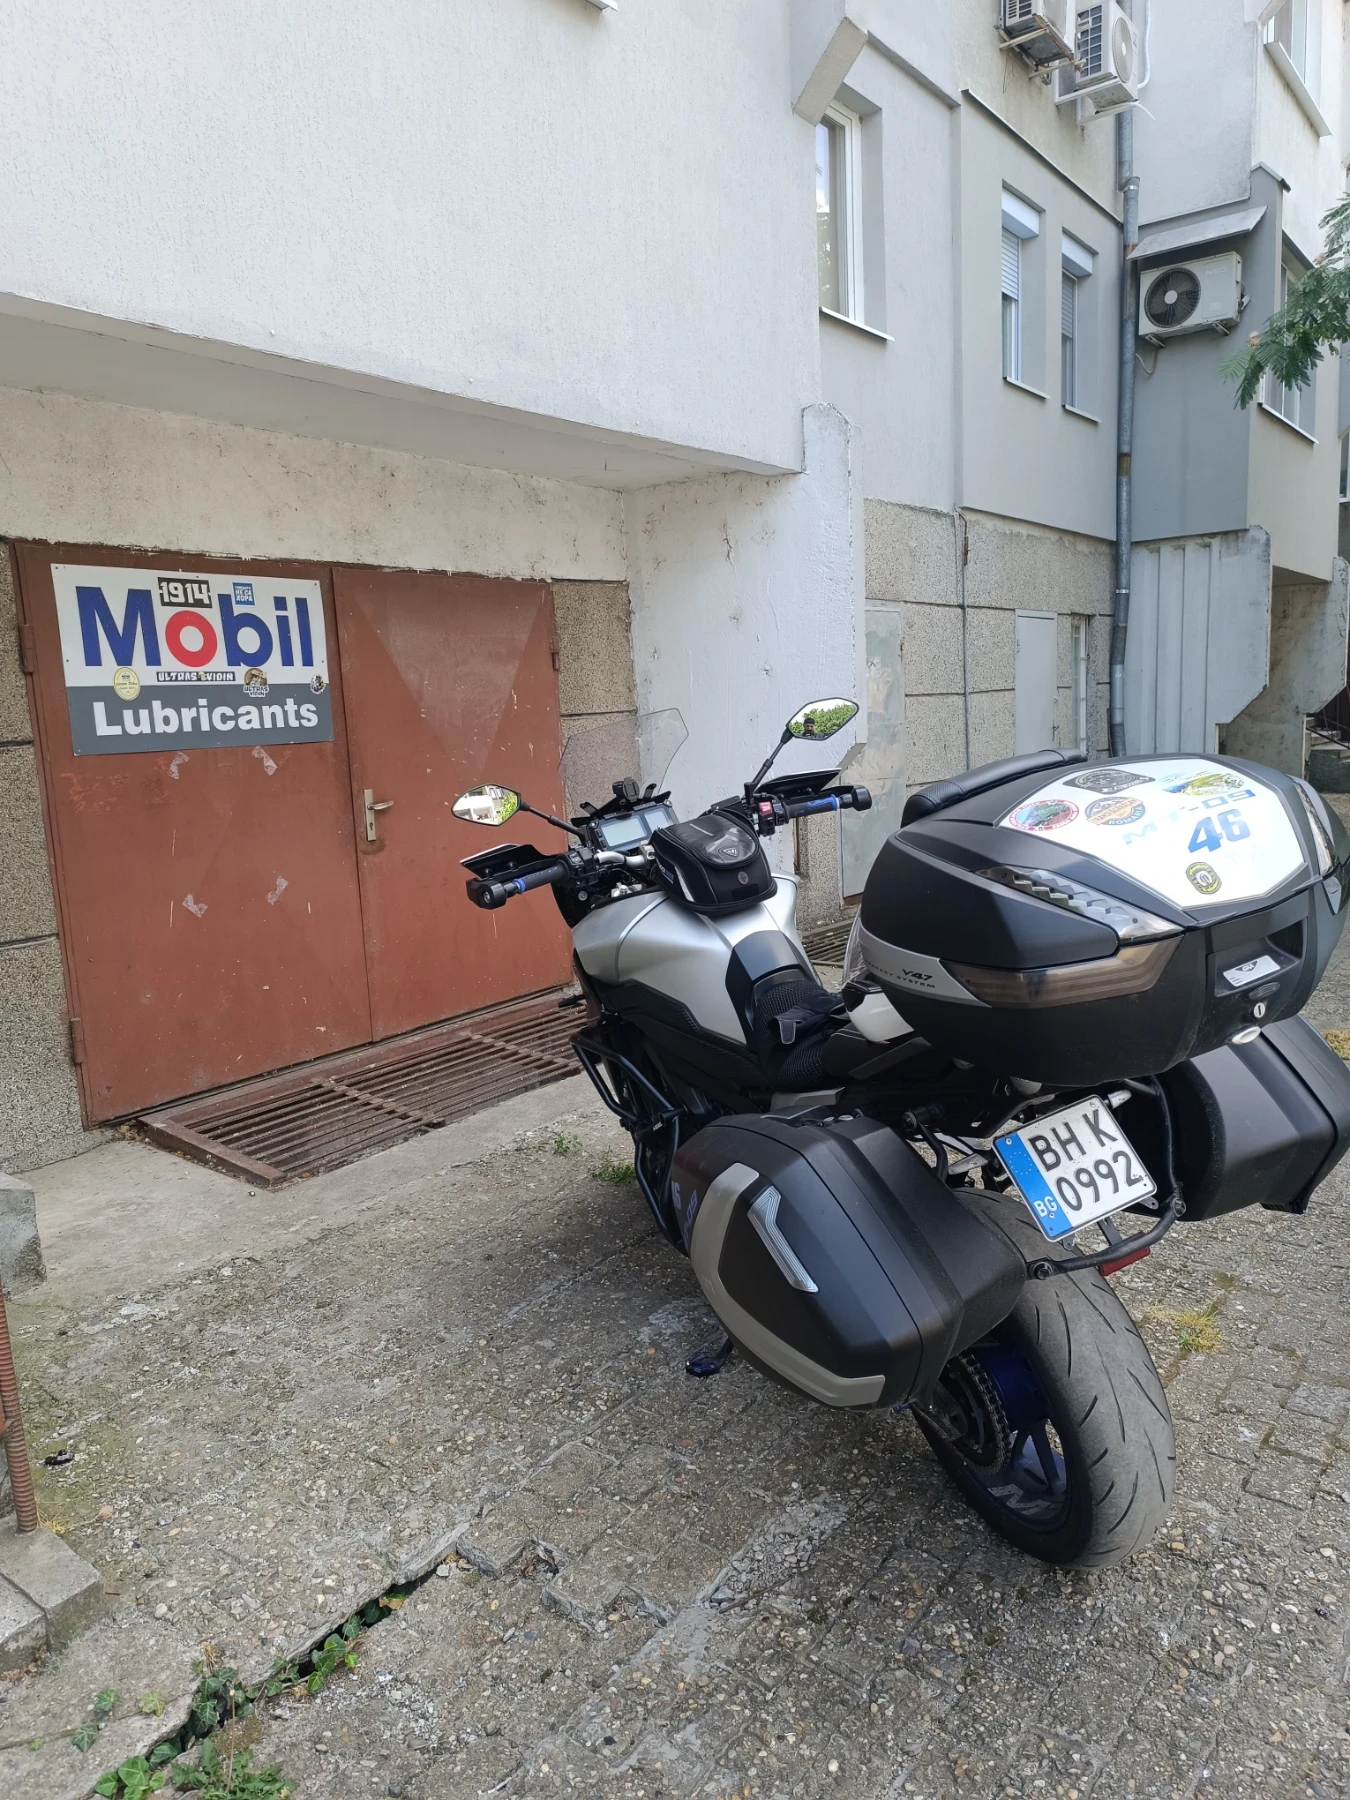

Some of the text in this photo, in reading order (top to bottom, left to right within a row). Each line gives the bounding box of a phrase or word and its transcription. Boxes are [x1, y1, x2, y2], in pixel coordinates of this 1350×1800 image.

[75, 586, 314, 668] Mobil
[158, 672, 234, 681] ULTRAS VIDIN
[93, 698, 319, 736] Lubricants
[1188, 808, 1251, 853] 46
[896, 975, 936, 989] SYSTEM
[902, 968, 933, 981] V47
[1027, 1109, 1118, 1172] BH K
[1056, 1150, 1143, 1212] 0992
[1033, 1196, 1058, 1218] BG
